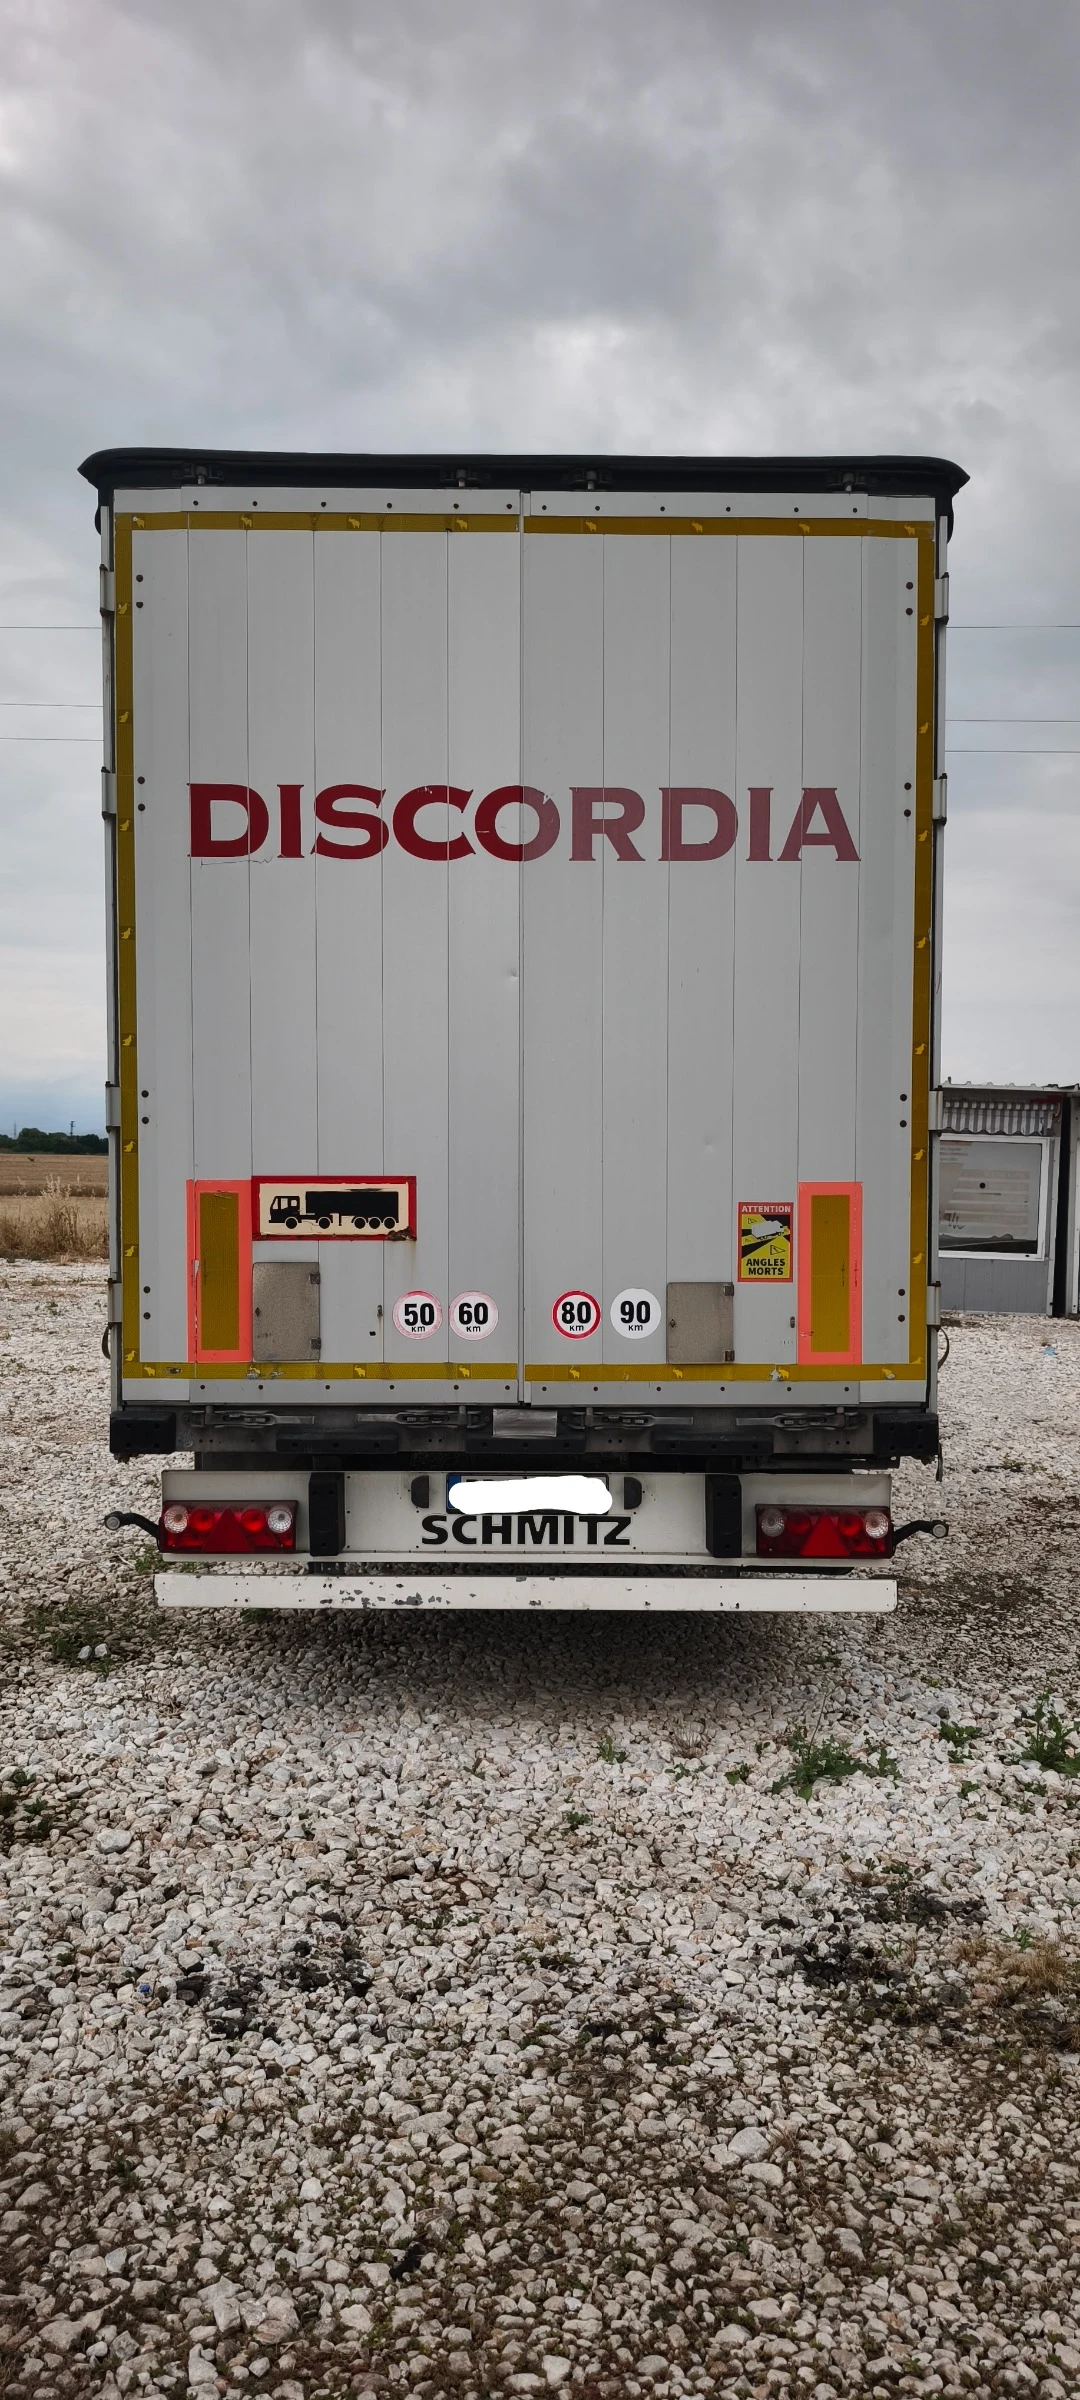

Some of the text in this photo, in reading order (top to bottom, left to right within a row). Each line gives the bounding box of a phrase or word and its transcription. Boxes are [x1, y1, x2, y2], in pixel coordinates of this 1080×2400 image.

[187, 783, 861, 862] DISCORDIA
[741, 1205, 791, 1213] ATTENTION
[746, 1258, 786, 1267] ANGLES
[748, 1267, 784, 1276] MORTS
[404, 1303, 435, 1326] 50
[458, 1302, 489, 1326] 60
[561, 1301, 592, 1325] 80
[620, 1300, 651, 1324] 90
[421, 1515, 632, 1546] SCHMITZ
